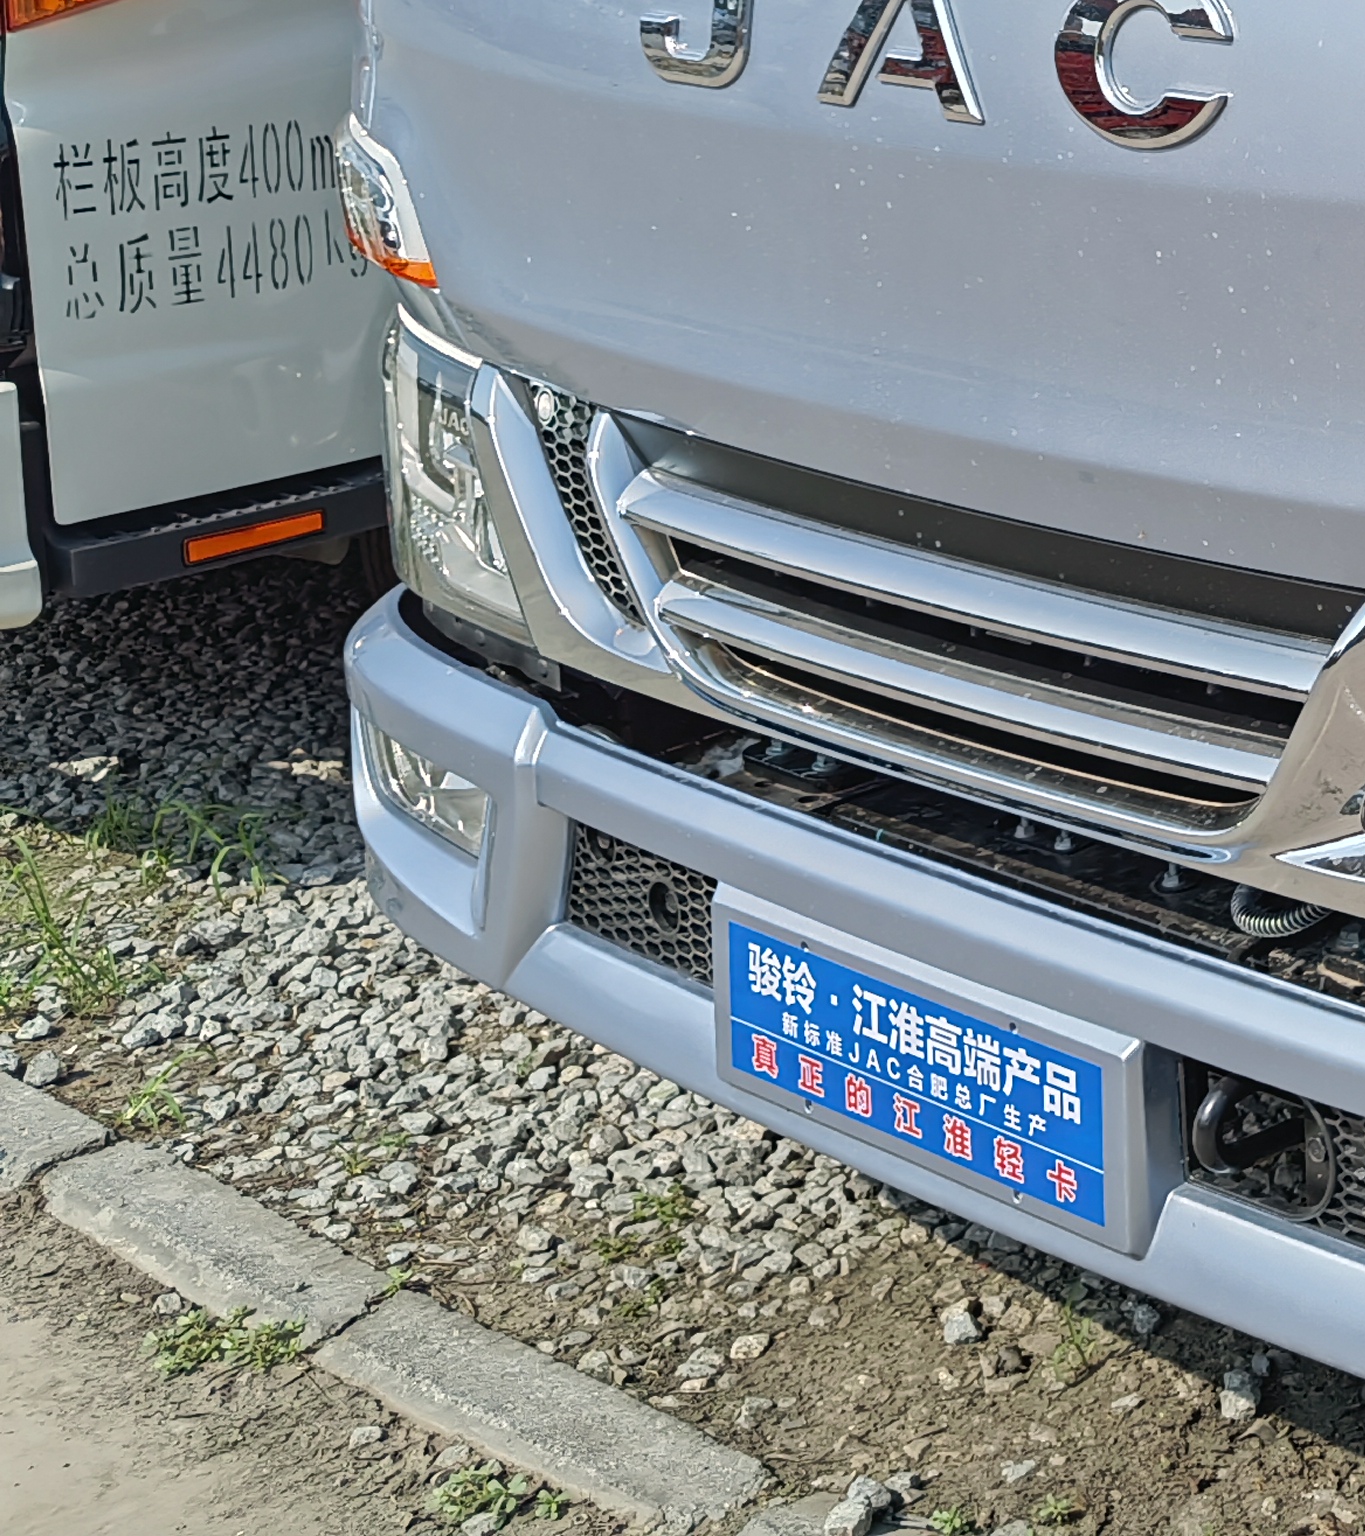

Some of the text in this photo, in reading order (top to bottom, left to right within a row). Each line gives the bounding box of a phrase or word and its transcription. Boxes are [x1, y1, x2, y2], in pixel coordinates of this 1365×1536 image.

[53, 118, 337, 221] 栏板高度400m
[751, 1034, 1078, 1203] 真正的江淮轻卡
